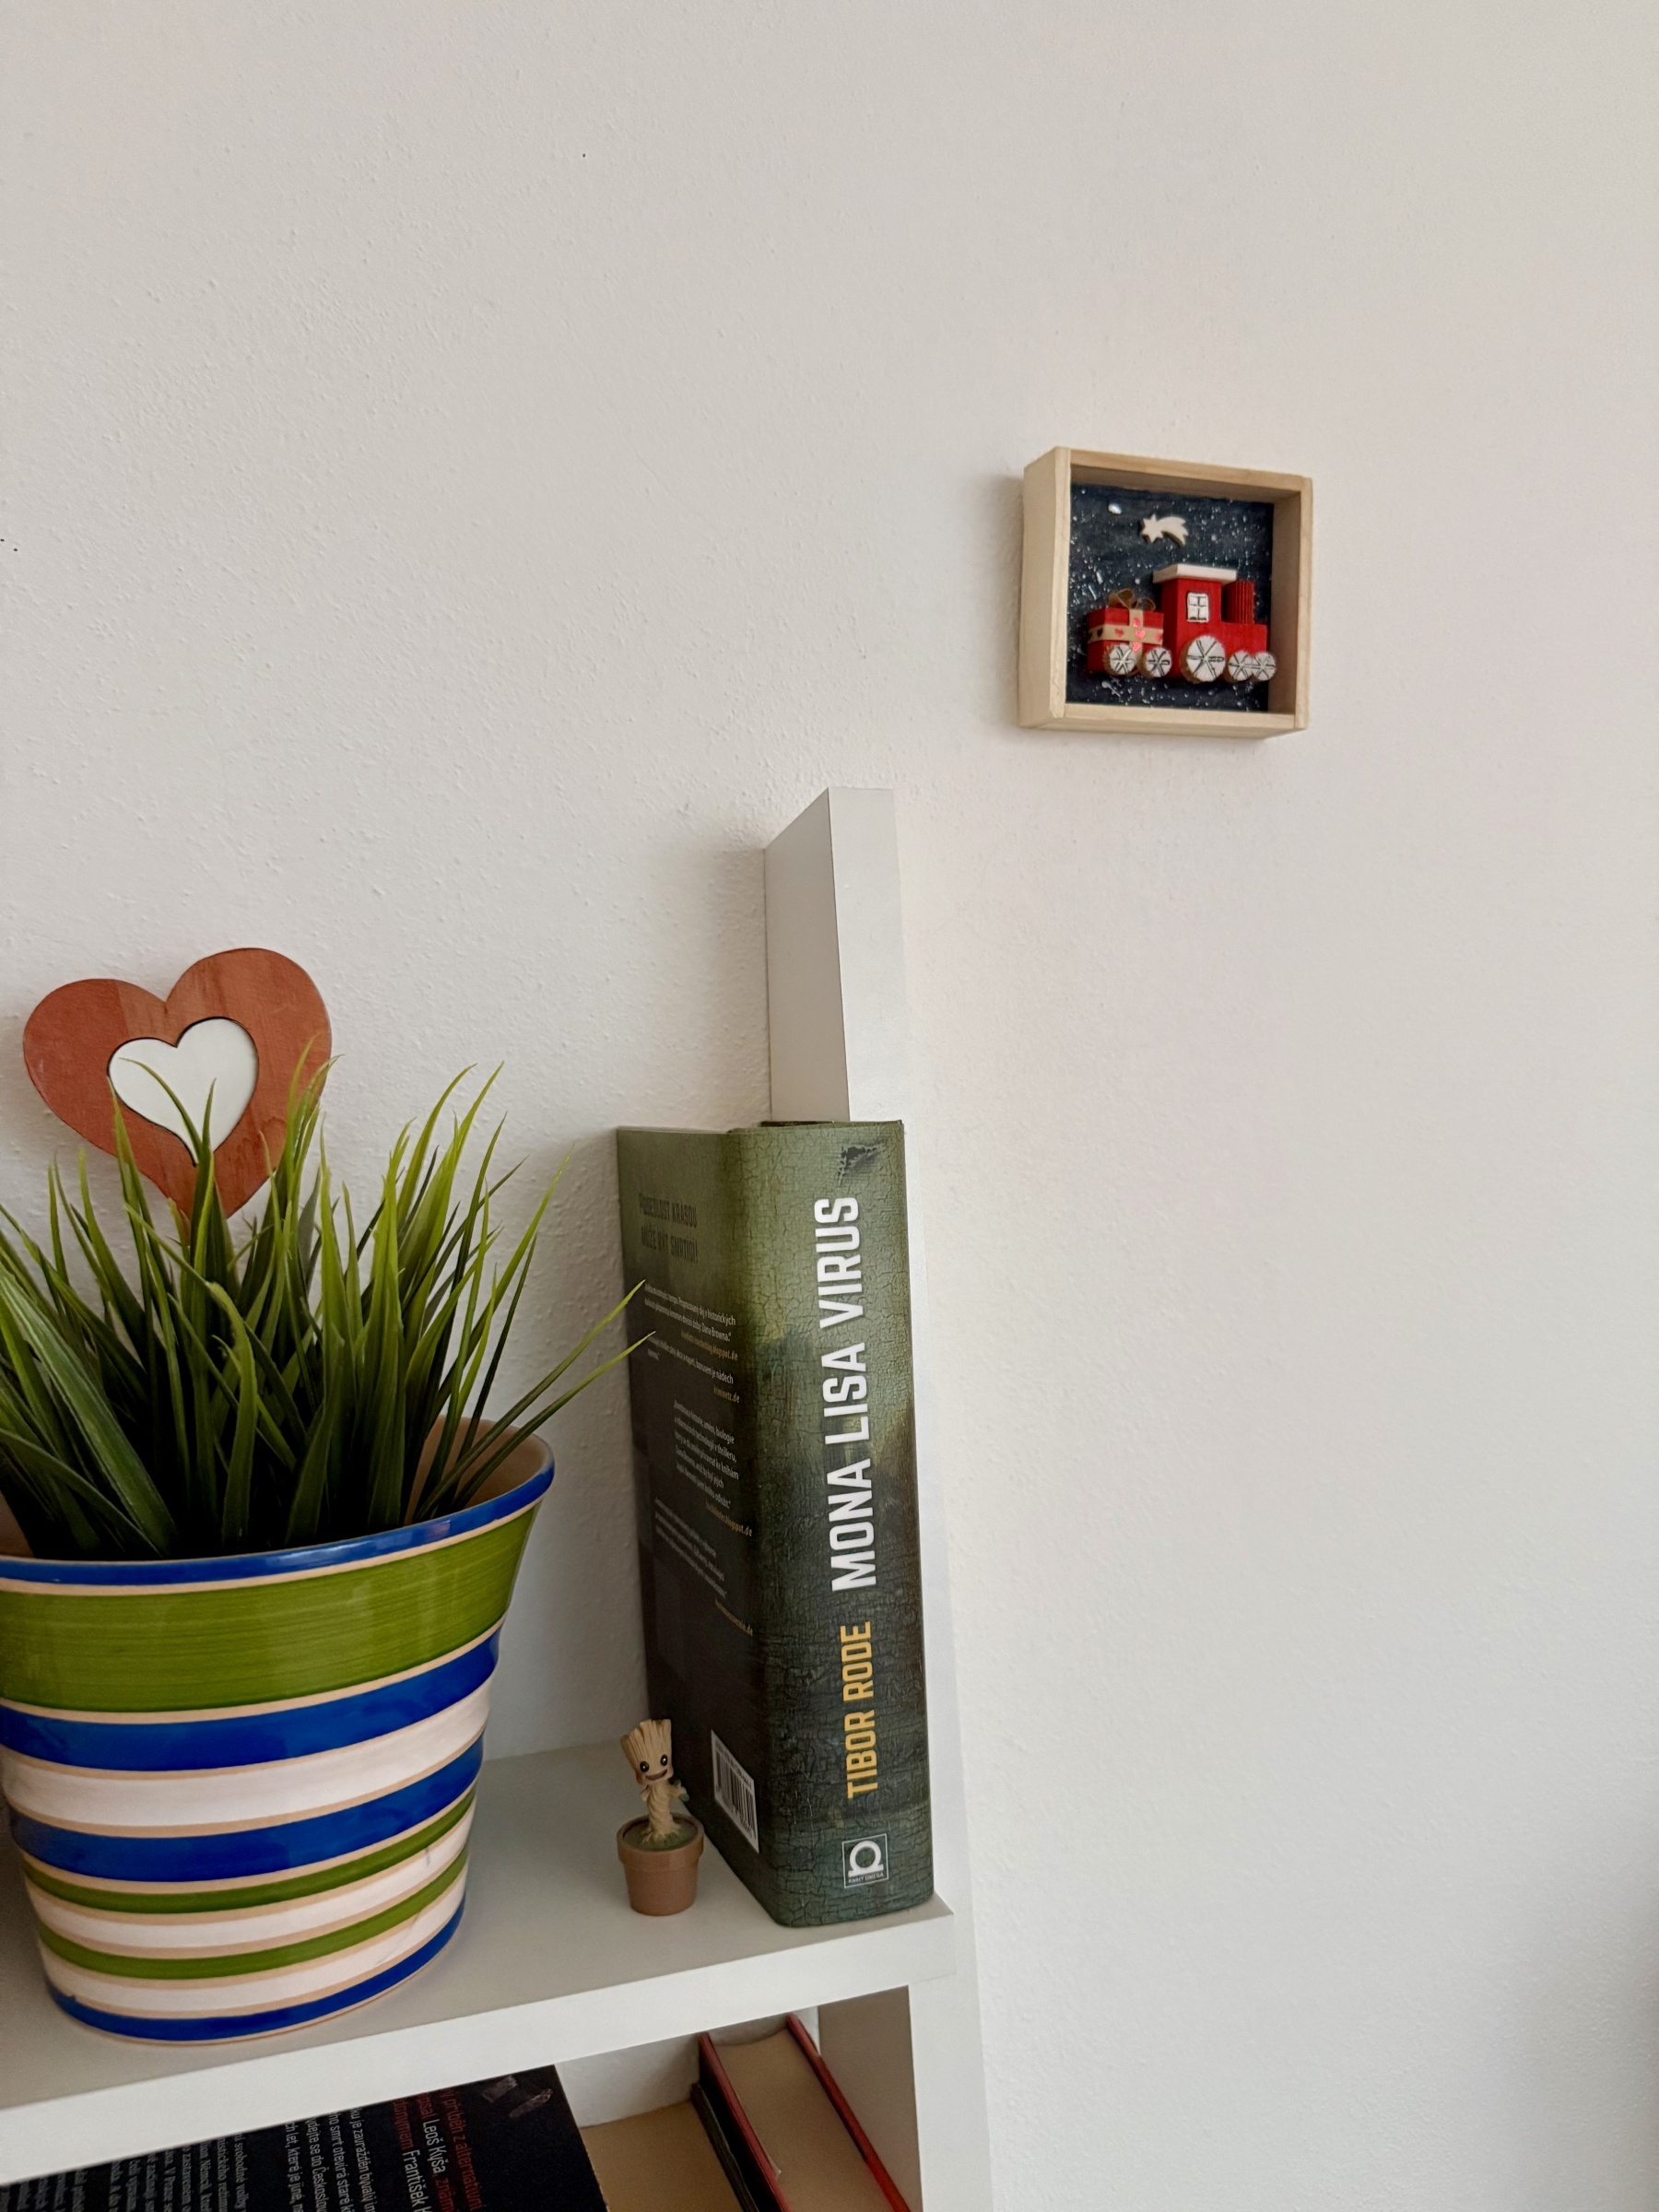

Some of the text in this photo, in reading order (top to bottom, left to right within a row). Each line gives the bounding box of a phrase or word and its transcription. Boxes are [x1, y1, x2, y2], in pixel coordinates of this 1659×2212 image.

[672, 1198, 698, 1229] KRÁSOU
[708, 1309, 735, 1327] historických
[716, 1367, 733, 1384] nádech
[814, 1197, 876, 1591] MONA LISA VIRUS
[715, 1427, 734, 1445] biologie
[721, 1463, 738, 1481] knihám
[840, 1621, 877, 1799] TIBOR RODE
[330, 2125, 344, 2147] smrt
[349, 2120, 364, 2128] je
[422, 2119, 444, 2146] Leoš
[284, 2132, 301, 2148] let,
[309, 2144, 319, 2155] se
[353, 2128, 371, 2172] zavražděn
[235, 2143, 249, 2183] svobodné
[288, 2147, 304, 2172] které
[311, 2155, 324, 2168] do
[332, 2147, 349, 2180] otevírá
[427, 2146, 449, 2177] Kyša,
[442, 2100, 467, 2134] příběh
[455, 2143, 487, 2211] alternativní
[288, 2172, 303, 2182] je
[359, 2172, 378, 2202] bývalý
[402, 2150, 429, 2207] František
[233, 2183, 249, 2208] volby
[336, 2180, 353, 2206] staré
